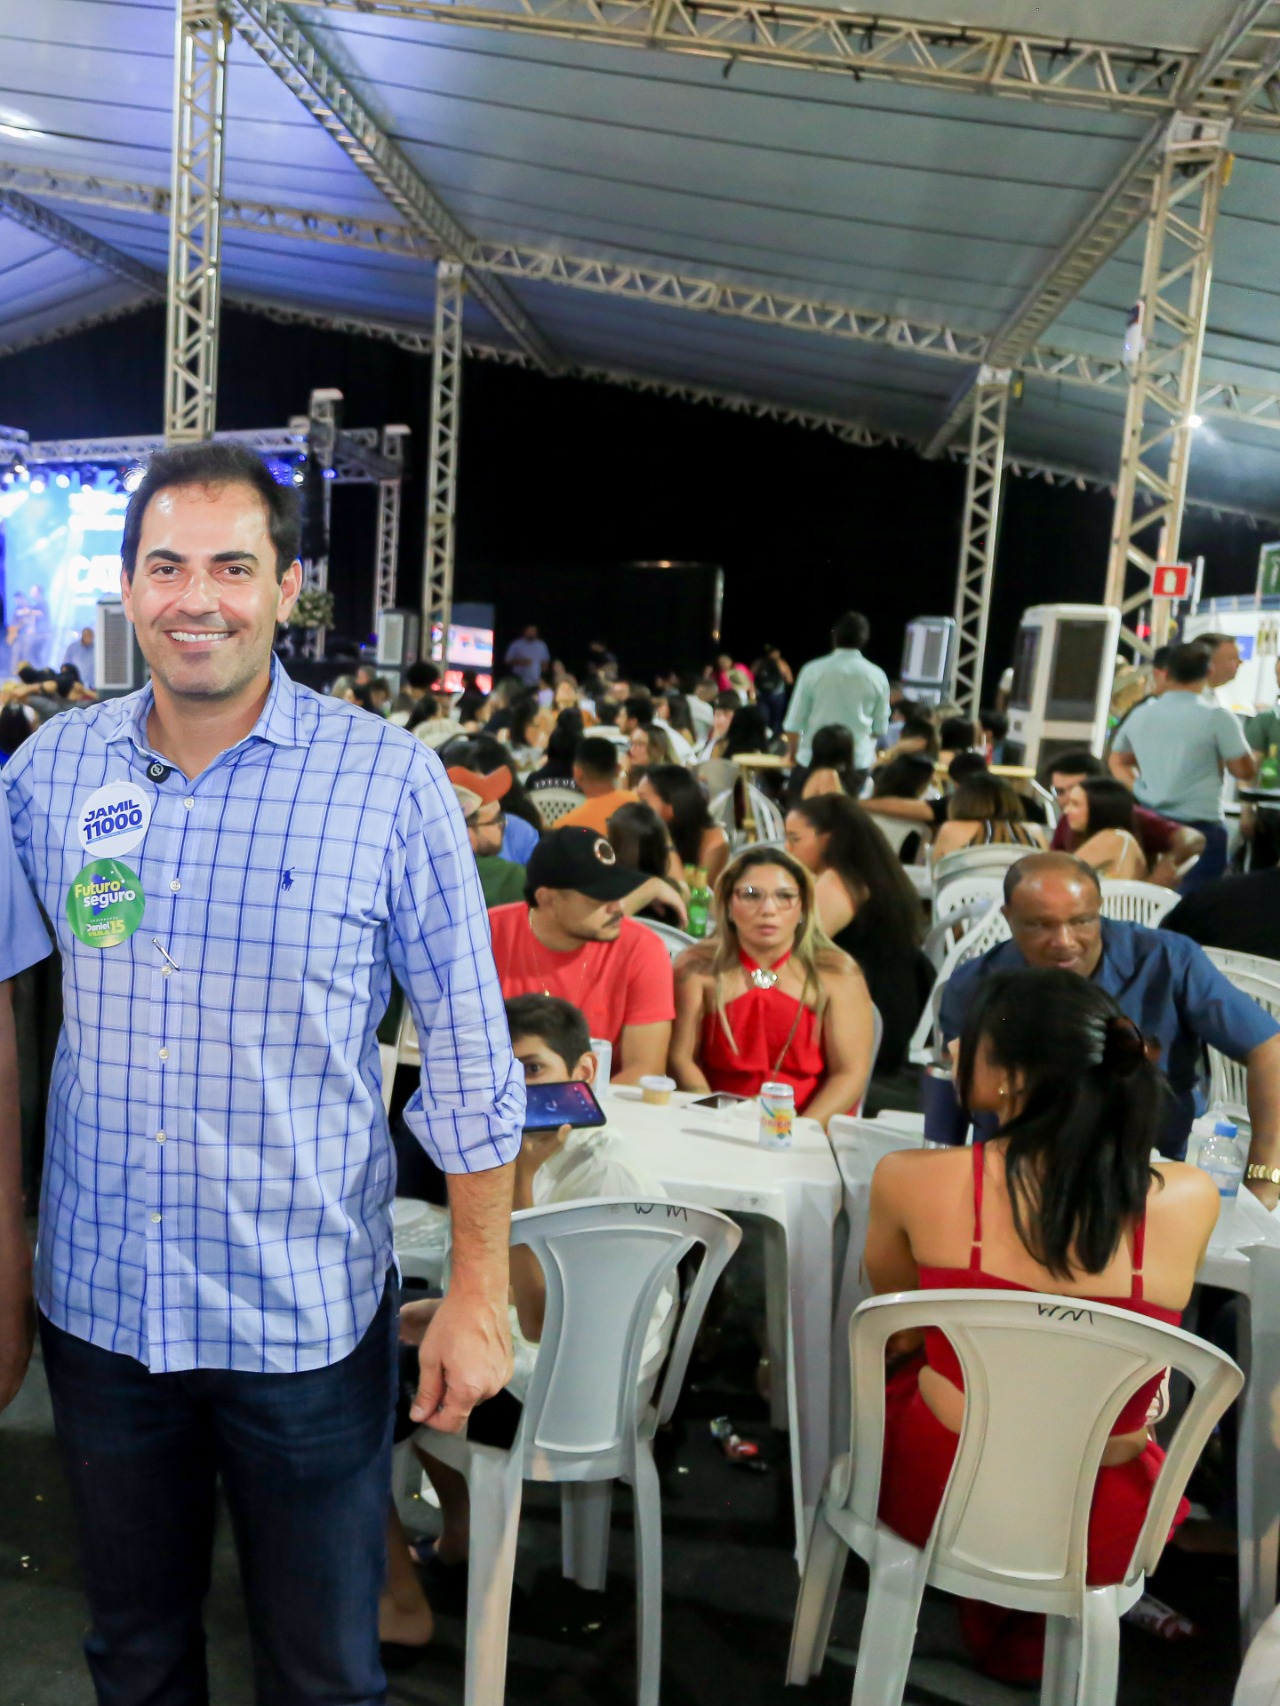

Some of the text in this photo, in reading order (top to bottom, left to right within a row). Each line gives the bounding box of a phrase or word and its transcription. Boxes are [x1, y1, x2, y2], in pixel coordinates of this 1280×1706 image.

[84, 799, 140, 822] JAMIL
[83, 809, 143, 840] 11000
[74, 880, 121, 898] Futuro
[83, 890, 136, 908] seguro
[110, 920, 126, 934] 15
